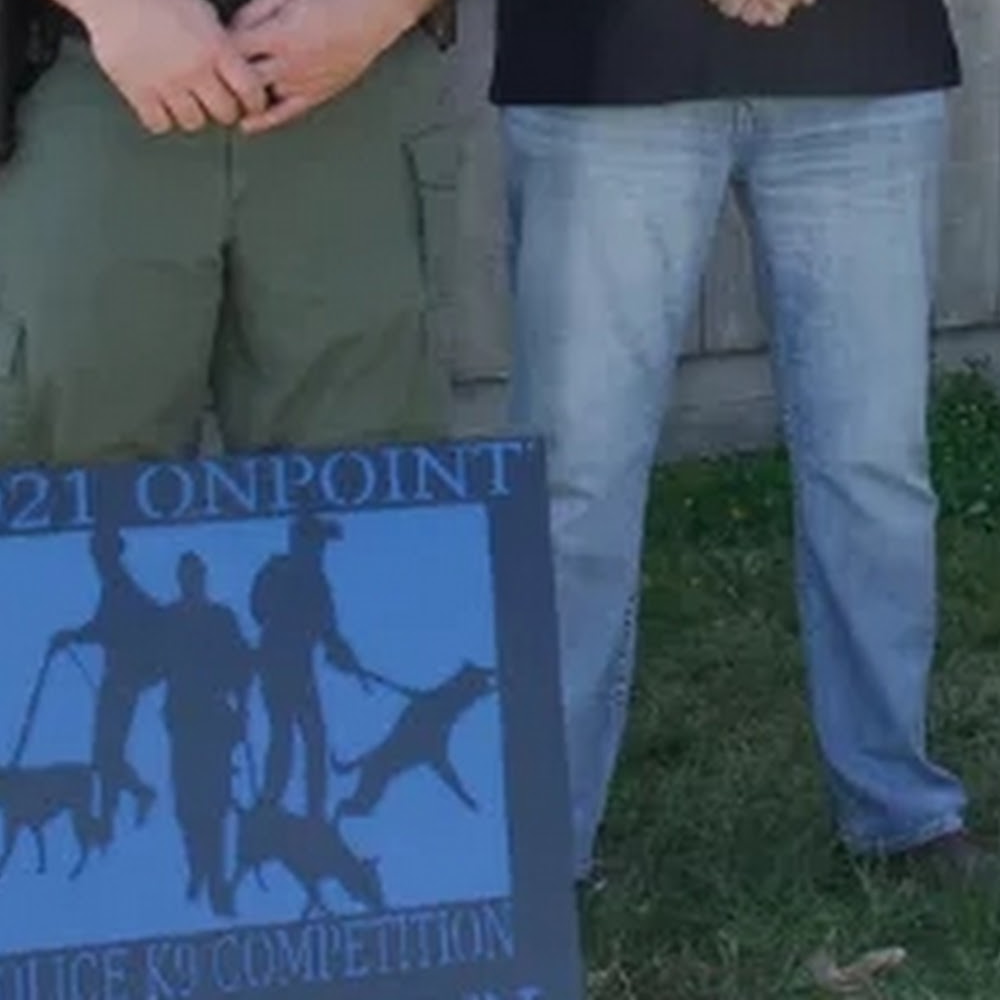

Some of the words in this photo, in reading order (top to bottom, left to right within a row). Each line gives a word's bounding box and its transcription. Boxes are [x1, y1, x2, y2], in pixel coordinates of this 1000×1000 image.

[0, 469, 96, 528] 21
[135, 442, 524, 519] ONPOINT
[212, 902, 516, 994] COMPETITION
